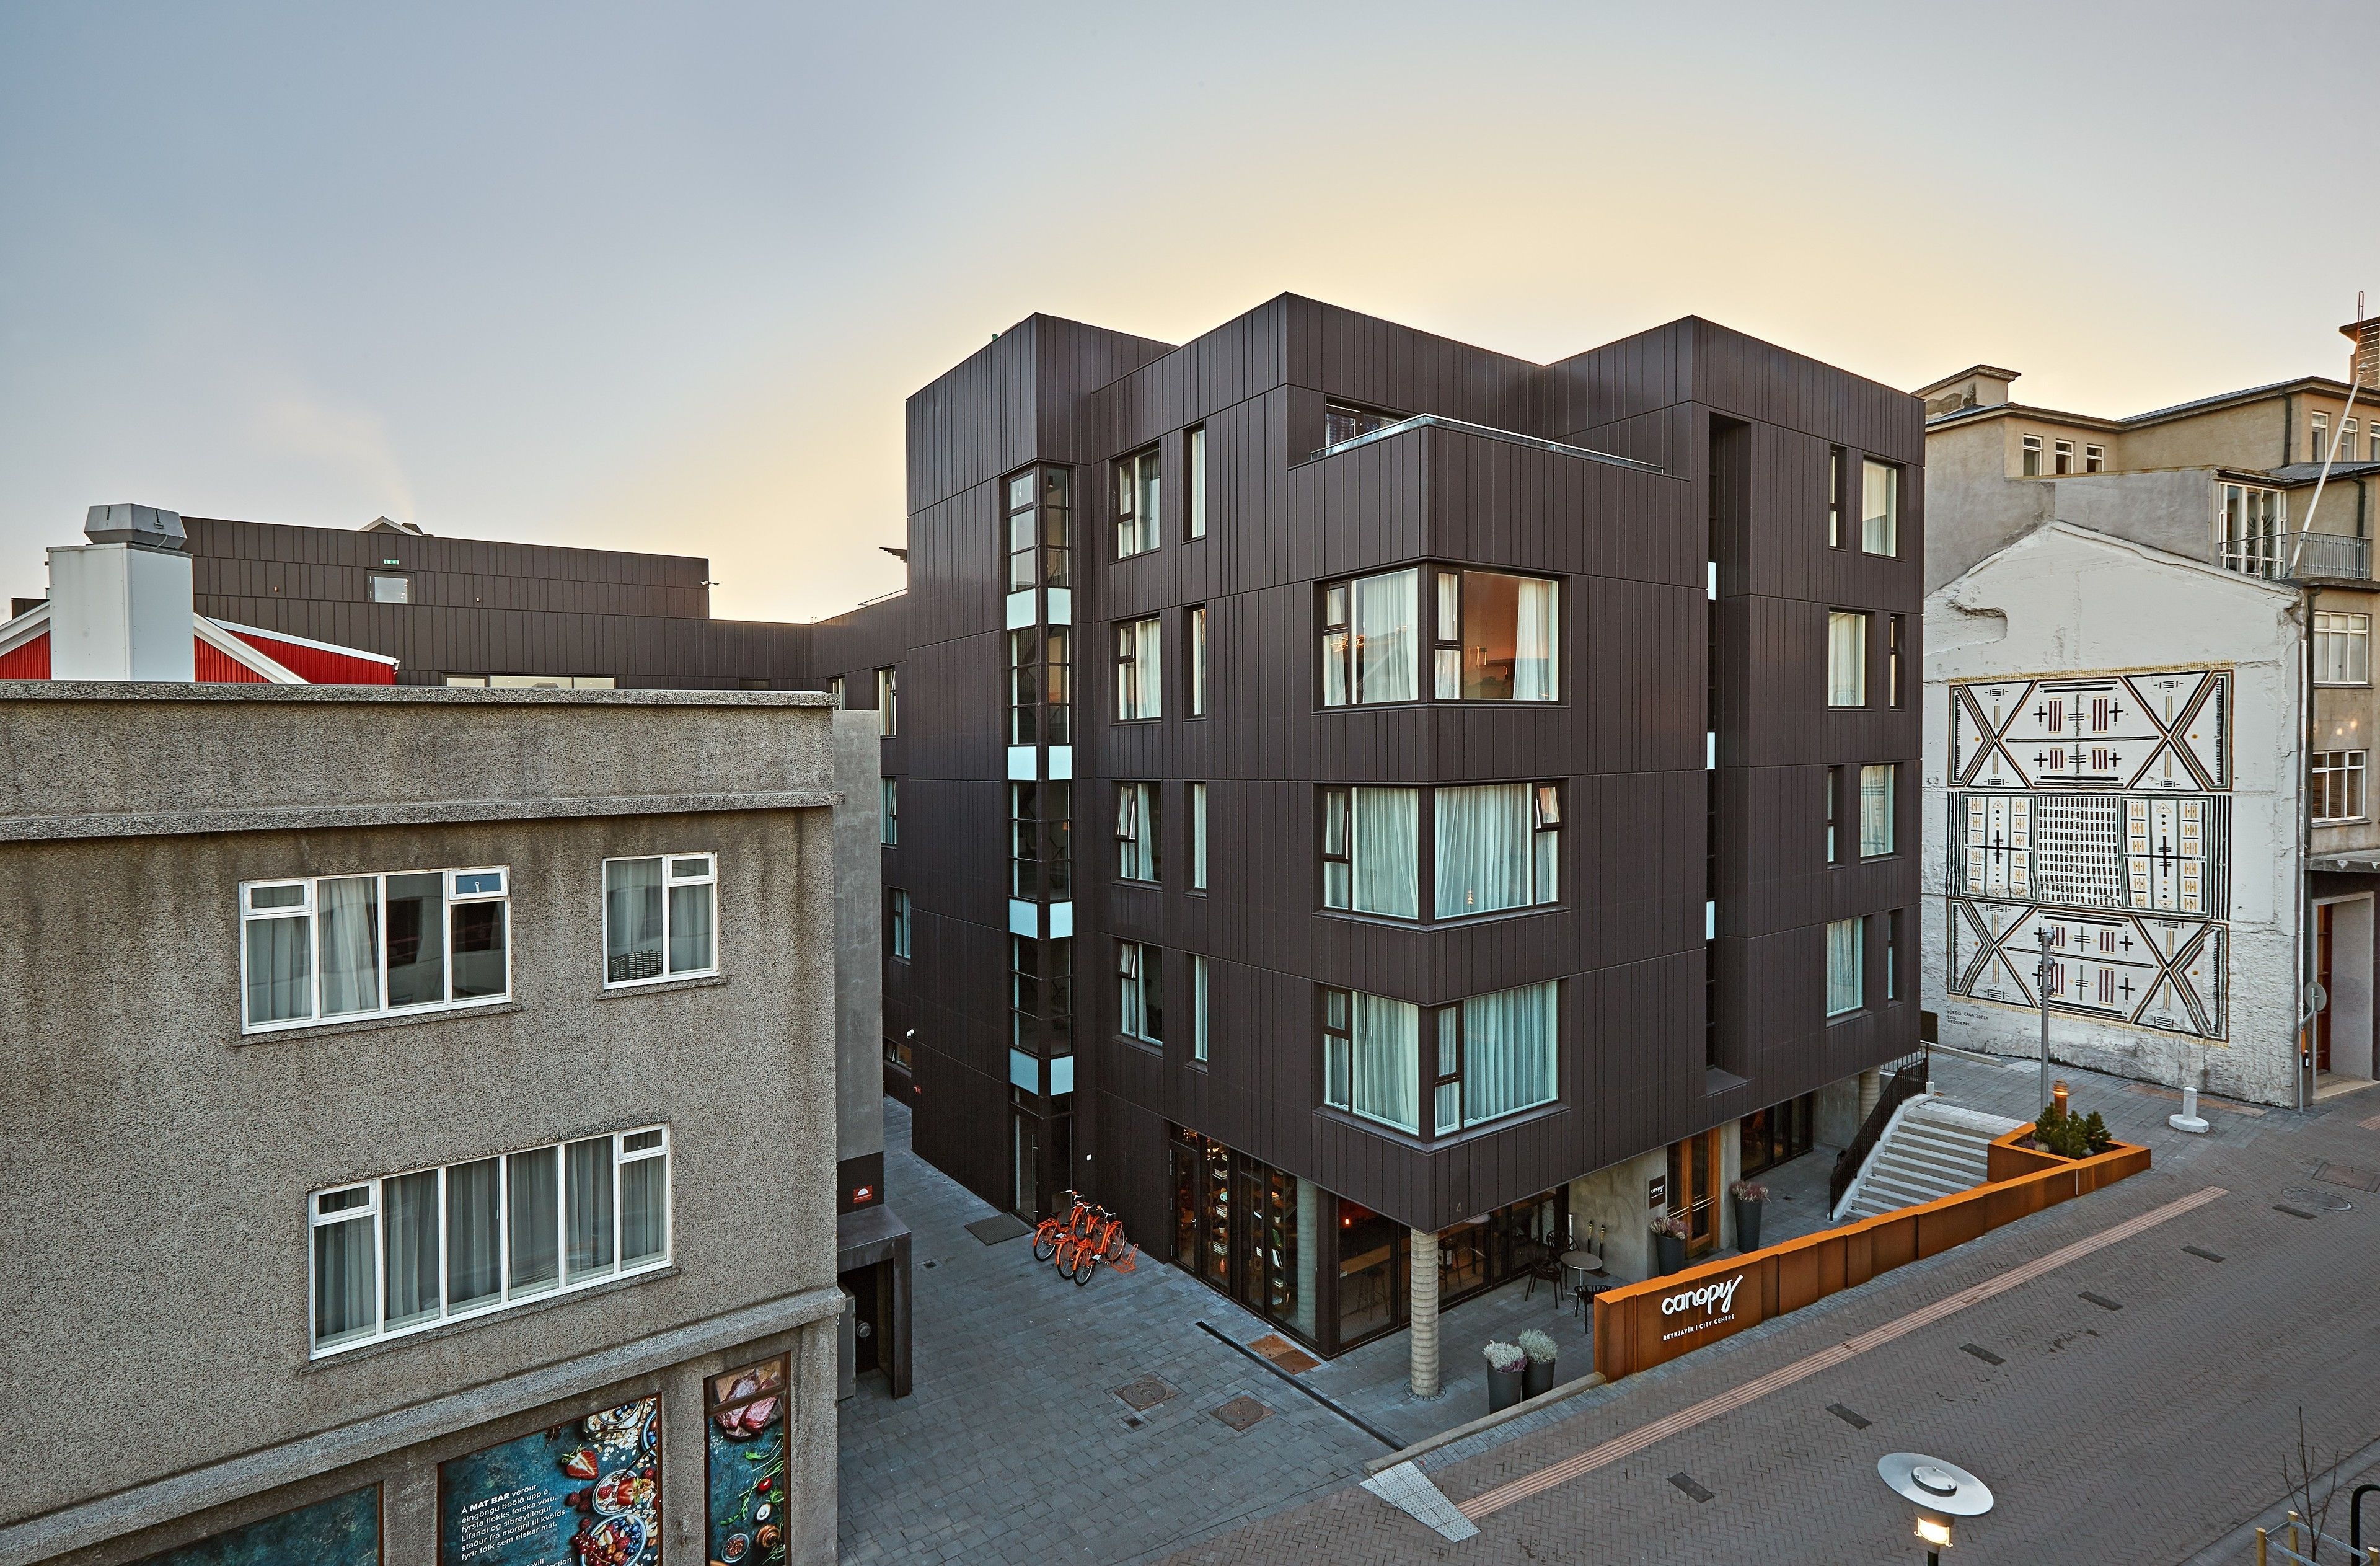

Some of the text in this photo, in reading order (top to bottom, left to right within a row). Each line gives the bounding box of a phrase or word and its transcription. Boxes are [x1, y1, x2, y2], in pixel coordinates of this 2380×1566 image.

[1651, 1184, 1665, 1193] canopy
[1456, 1201, 1462, 1213] 4
[1661, 1275, 1743, 1315] canopy
[1699, 1320, 1712, 1329] CITY
[1714, 1314, 1735, 1325] CENTRE
[461, 1484, 537, 1515] Á MAT BAR verður
[502, 1497, 524, 1510] boðið
[526, 1492, 542, 1501] upp
[461, 1496, 557, 1534] fyrsta flokks ferska vöru.
[461, 1527, 488, 1542] Lifandi
[490, 1523, 501, 1531] og
[461, 1537, 488, 1551] staður
[489, 1531, 500, 1541] frá
[502, 1521, 530, 1537] morgni
[461, 1521, 557, 1561] fyrir fólk sem elskar mat.
